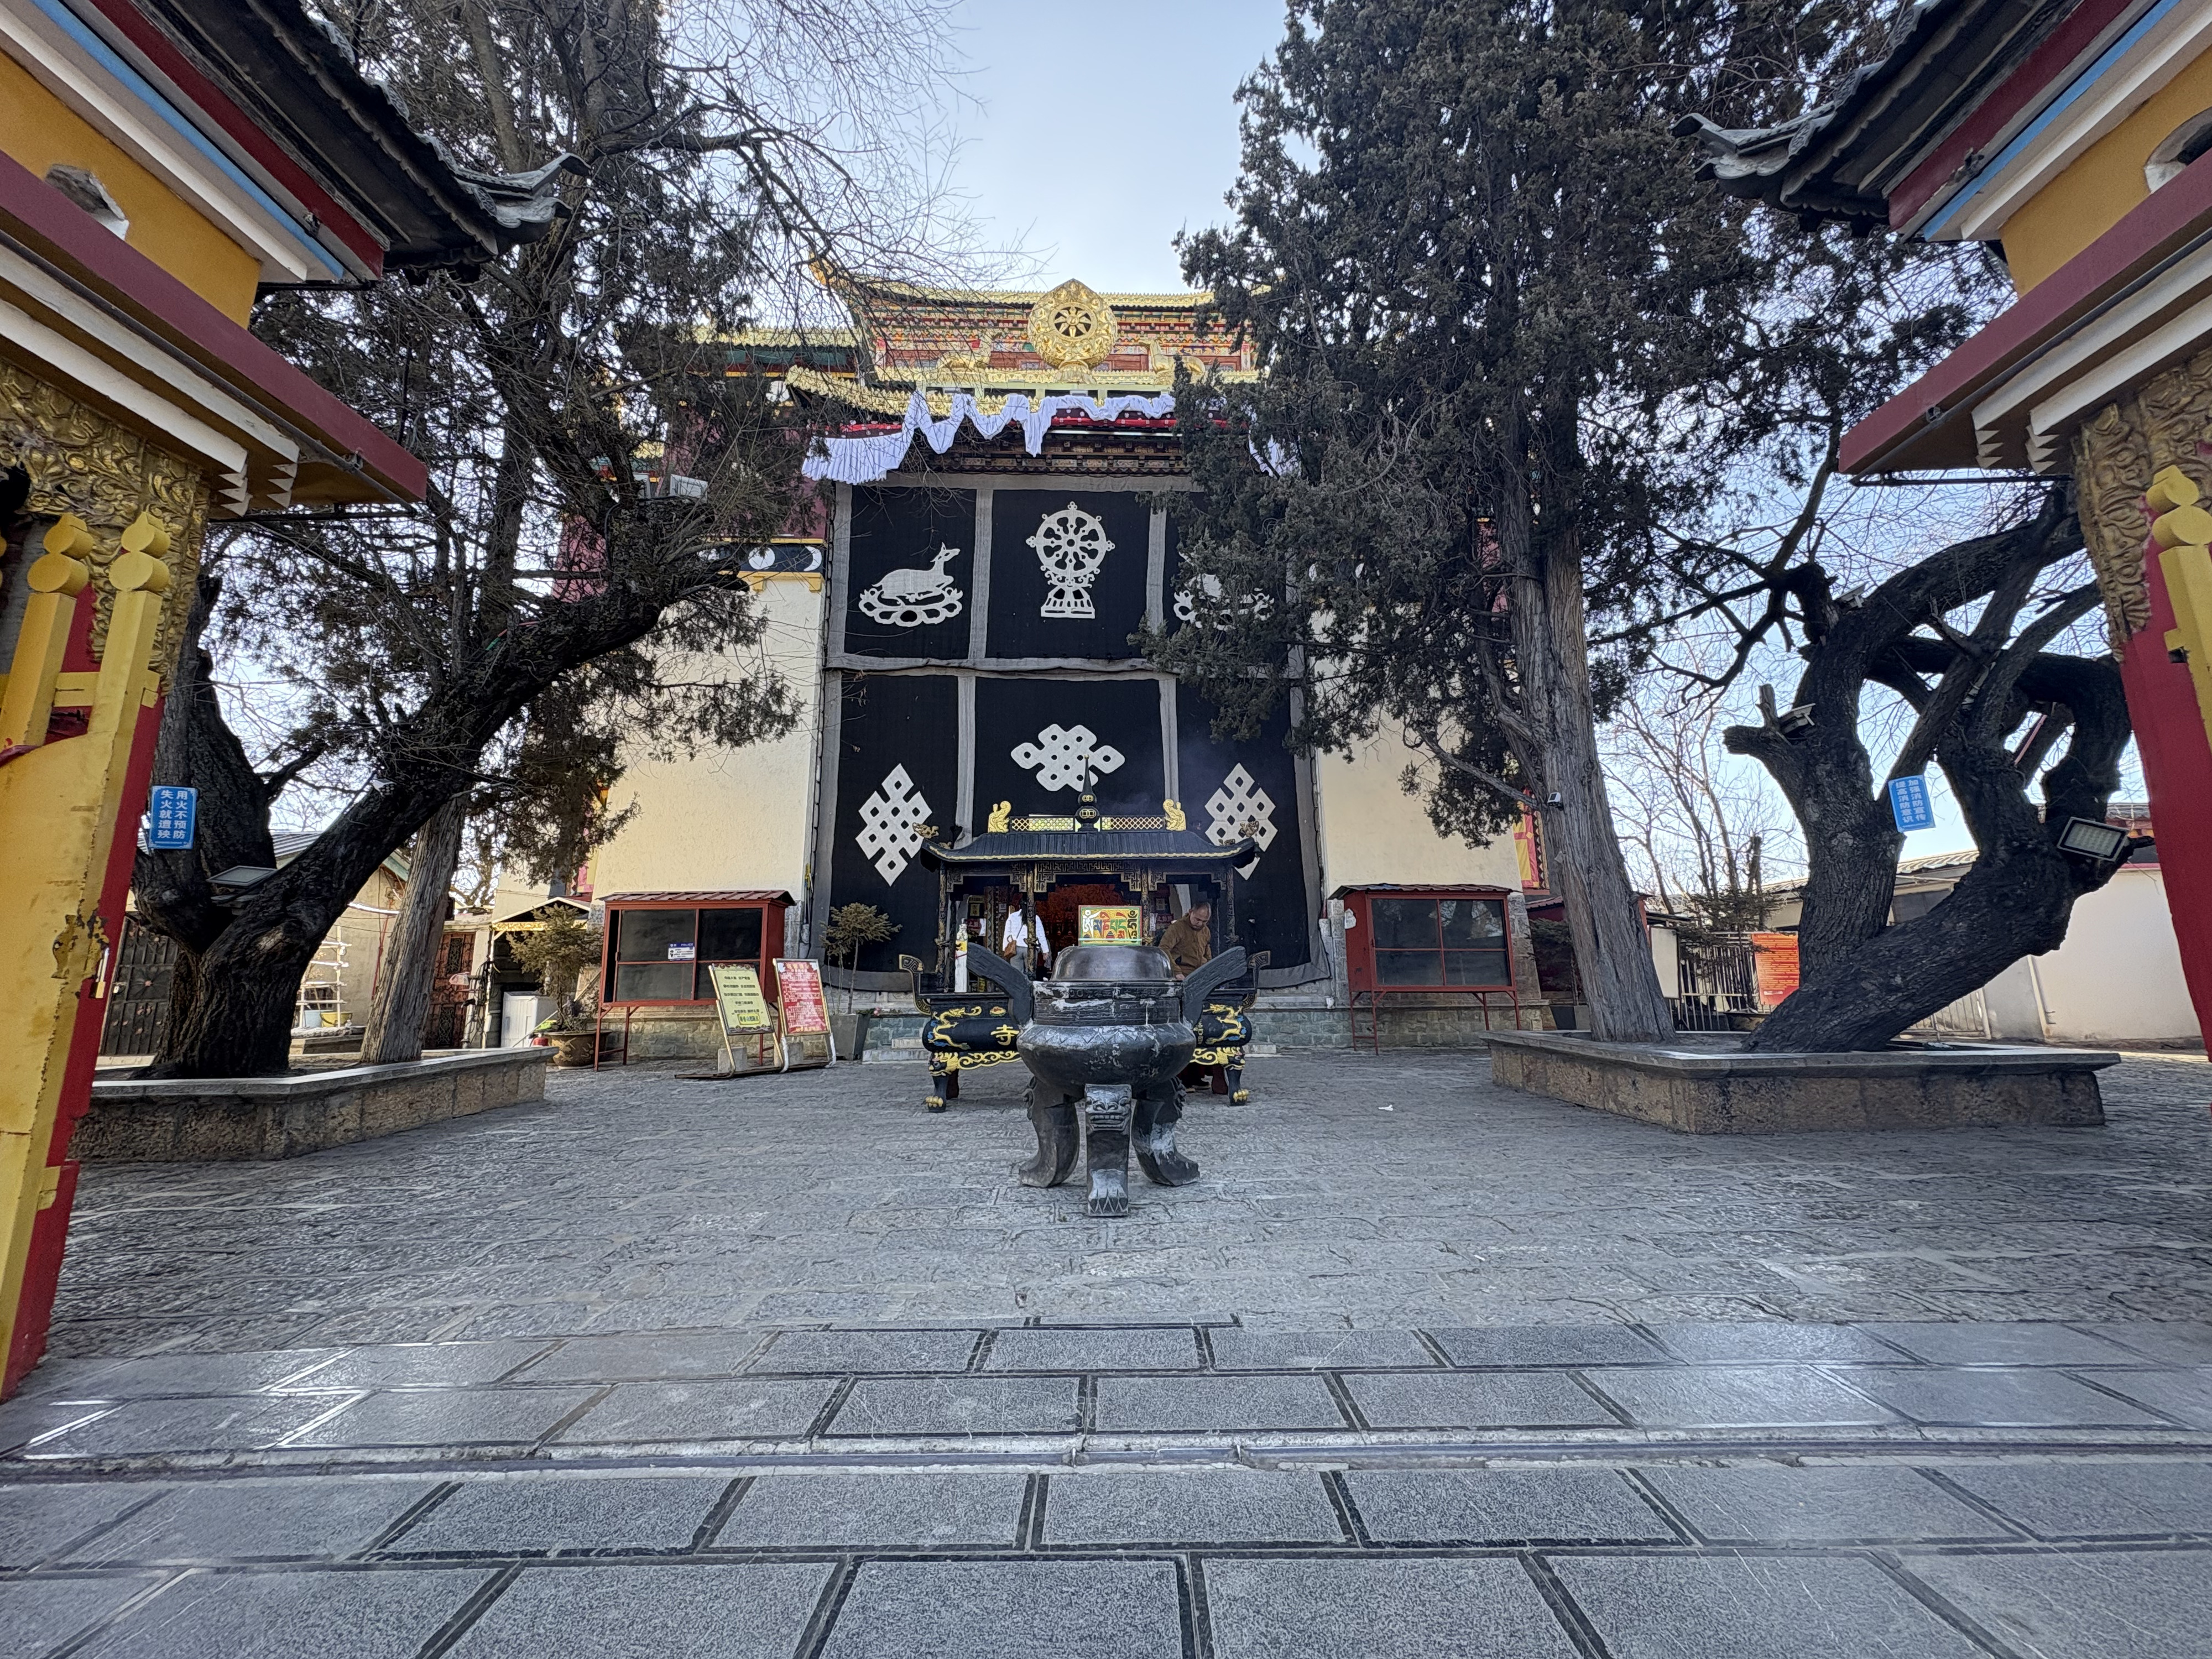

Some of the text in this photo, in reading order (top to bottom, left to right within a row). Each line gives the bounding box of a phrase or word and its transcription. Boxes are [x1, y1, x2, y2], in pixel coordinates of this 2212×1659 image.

[157, 790, 174, 839] 失火就遭殃
[173, 791, 188, 839] 用火不预防
[1895, 781, 1914, 823] 提高消防意识
[1907, 779, 1926, 821] 加强消防宣传
[990, 1024, 1020, 1046] 寺
